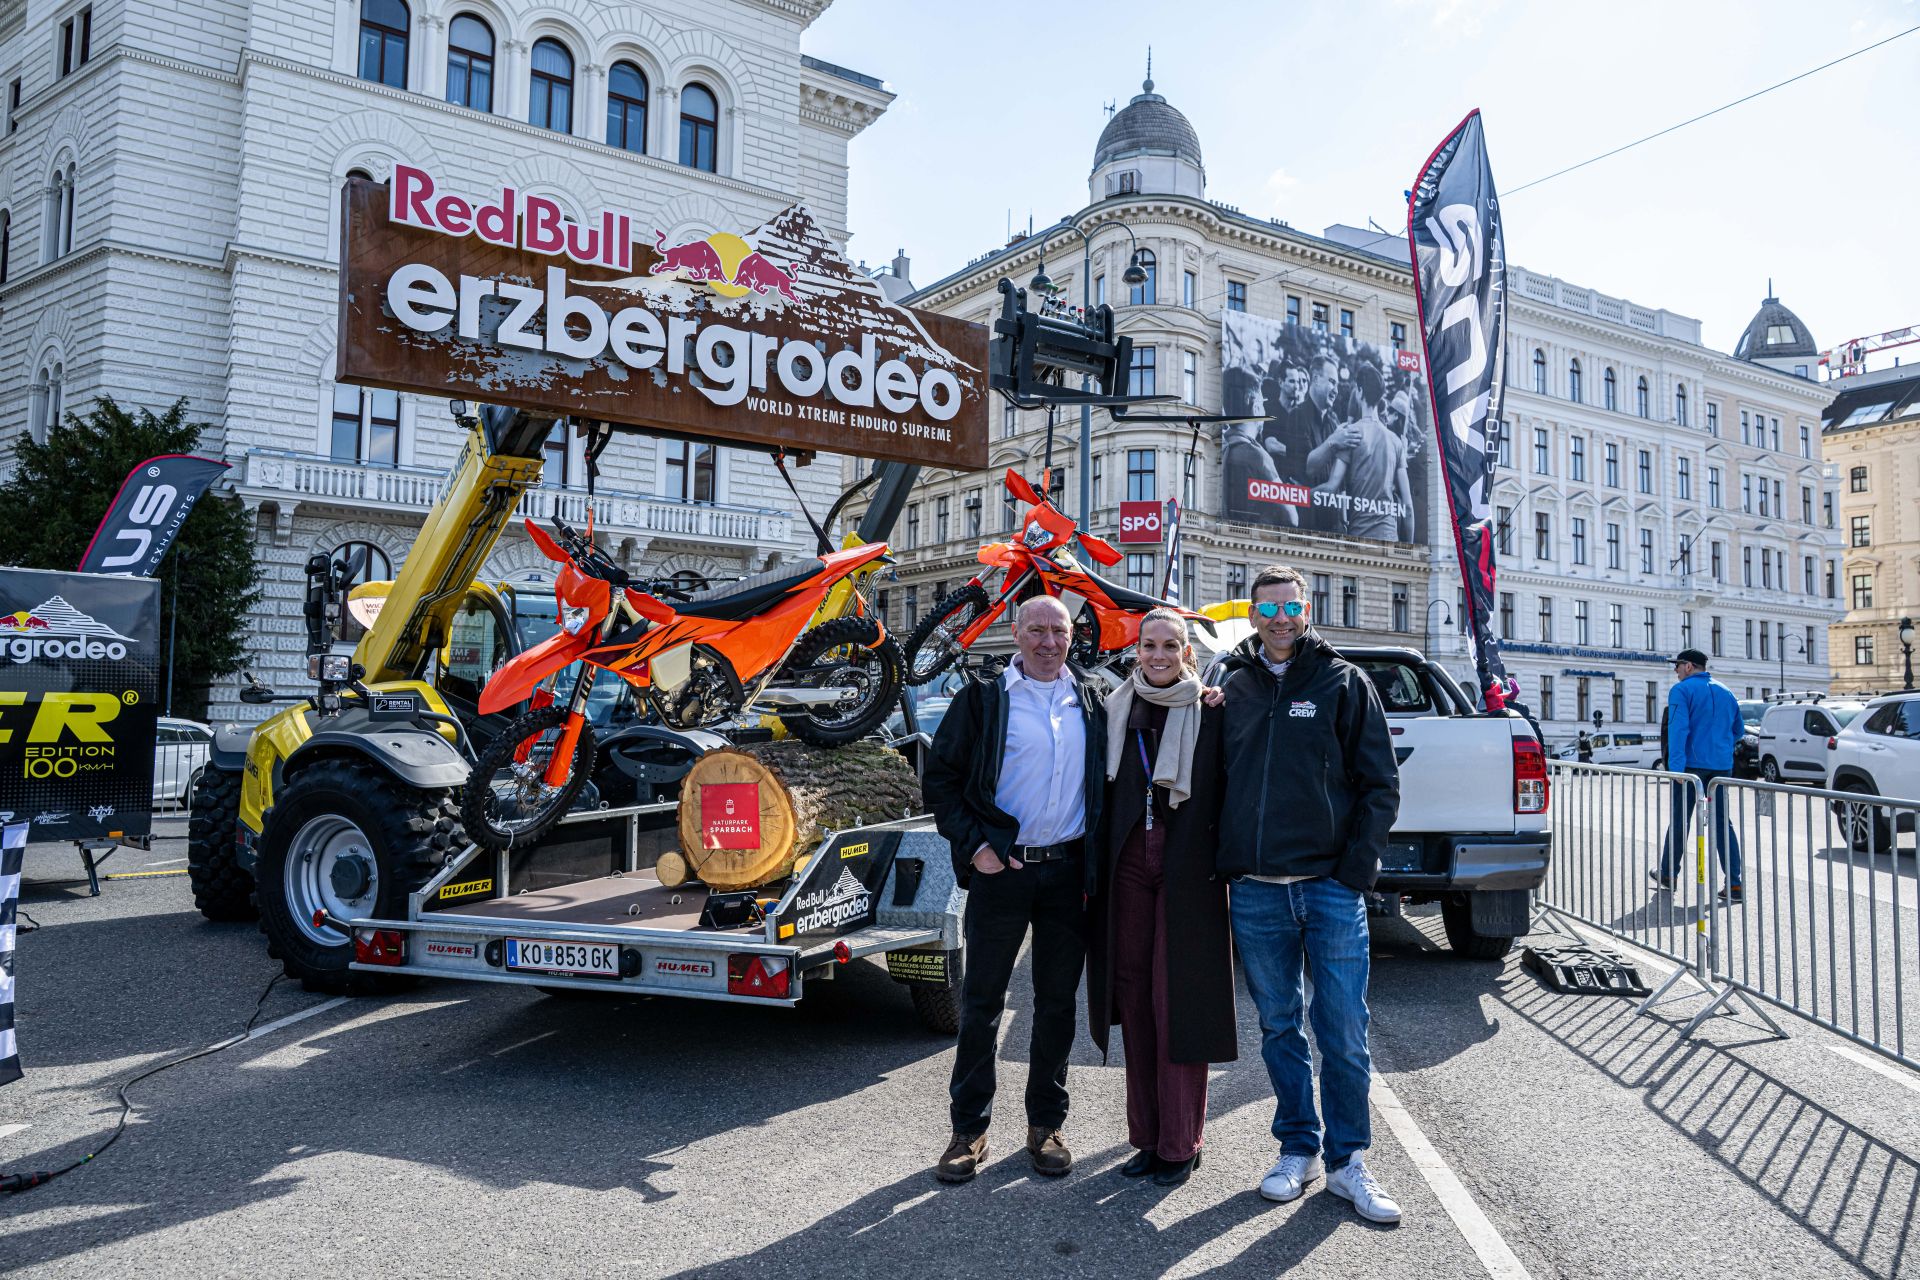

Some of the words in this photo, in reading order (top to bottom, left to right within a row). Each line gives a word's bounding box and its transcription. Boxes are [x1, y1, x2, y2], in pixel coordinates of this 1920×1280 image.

[394, 164, 515, 246] Red
[526, 195, 630, 269] Bull
[387, 263, 962, 421] erzbergrodeo
[1400, 355, 1419, 369] SPÖ
[746, 395, 793, 416] WORLD
[798, 405, 846, 425] XTREME
[850, 413, 898, 433] ENDURO
[902, 422, 952, 443] SUPREME
[1249, 481, 1308, 504] ORDNEN
[1313, 490, 1352, 510] STATT
[1354, 496, 1407, 518] SPALTEN
[150, 494, 195, 564] EXHAUSTS
[1121, 512, 1160, 532] SPÖ
[1288, 708, 1317, 718] CREW
[25, 746, 115, 757] EDITION
[24, 757, 78, 779] 100
[88, 808, 115, 816] KINI
[842, 844, 867, 857] HUMER
[442, 881, 489, 896] HUMER
[796, 892, 811, 911] Red
[811, 889, 825, 904] Bull
[796, 895, 869, 933] erzbergrodeo
[427, 943, 473, 955] HUMER
[510, 955, 516, 963] A
[520, 943, 541, 965] KO
[555, 945, 587, 967] 853
[591, 947, 613, 970] GK
[888, 953, 946, 964] HUMER
[657, 961, 710, 974] HUMER
